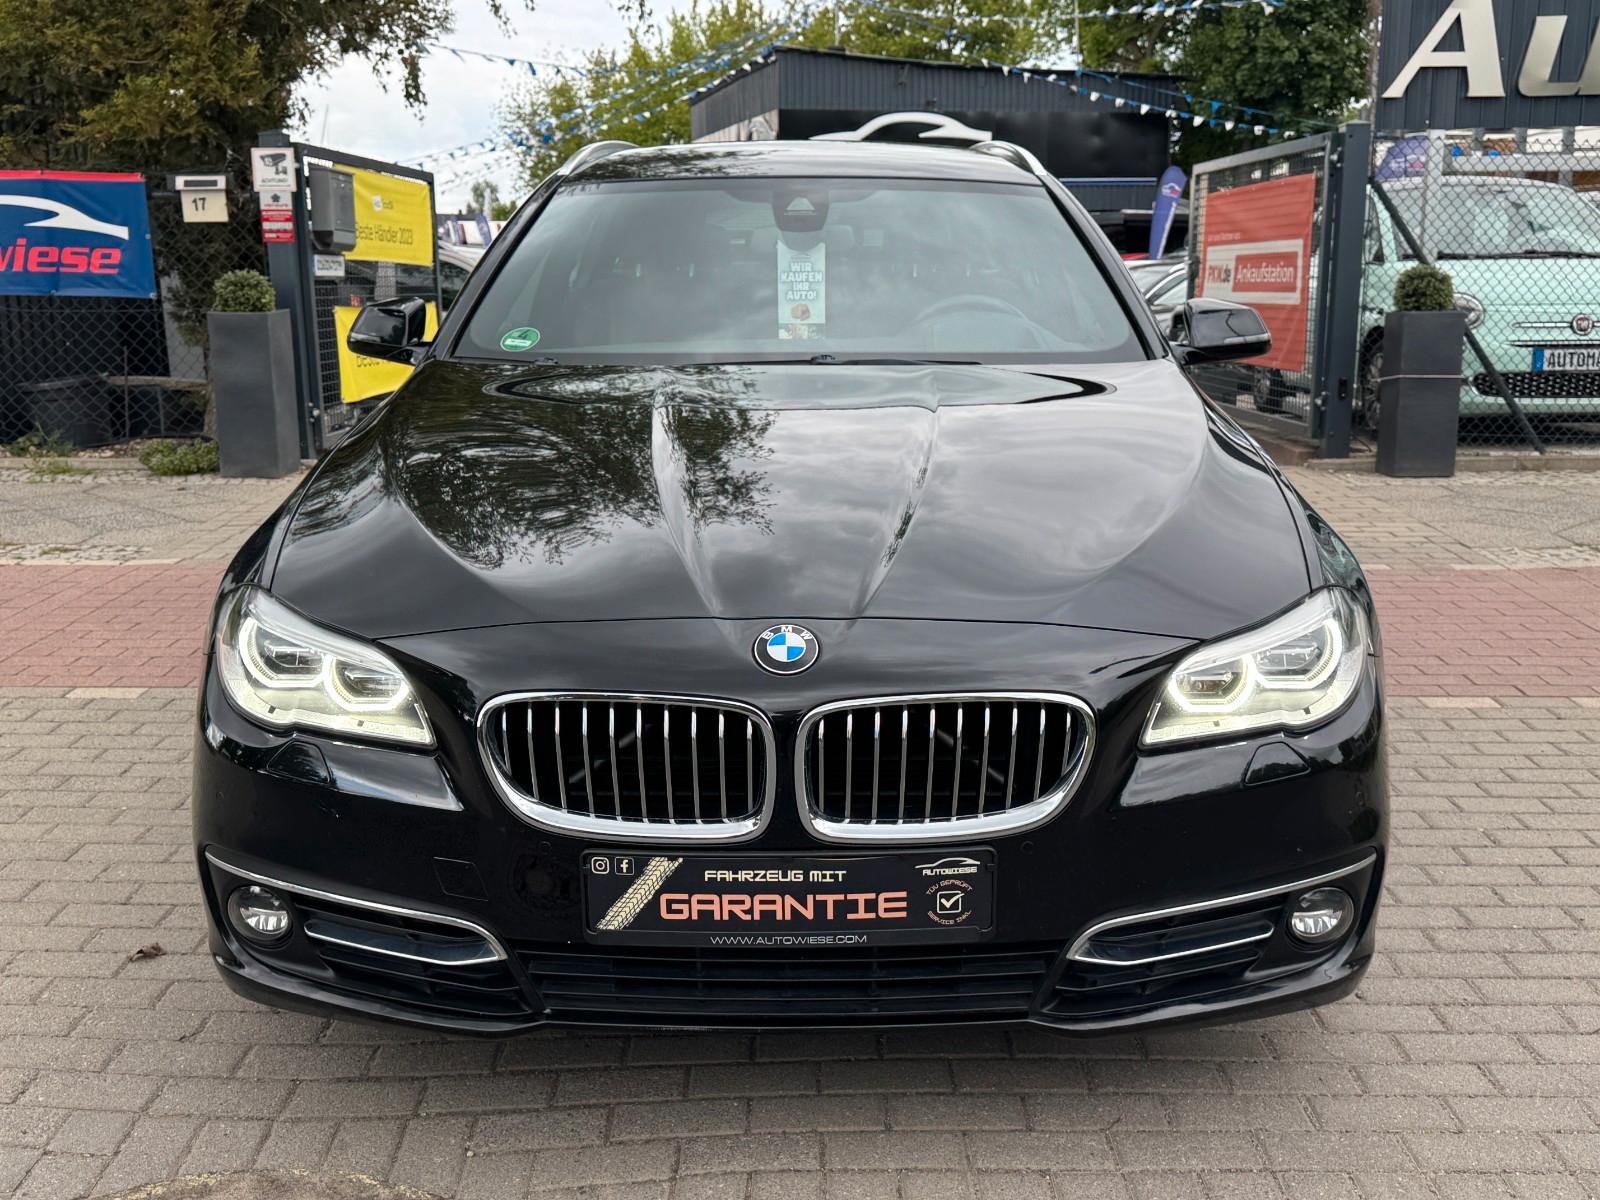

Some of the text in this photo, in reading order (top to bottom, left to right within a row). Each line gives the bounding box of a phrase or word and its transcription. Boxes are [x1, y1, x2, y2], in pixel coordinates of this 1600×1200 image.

[192, 197, 207, 211] 17
[790, 262, 812, 272] WIR
[1235, 261, 1294, 283] Ankaufstation
[781, 272, 823, 282] KAUFEN
[793, 282, 810, 291] IHR
[786, 291, 817, 301] AUTO!
[761, 626, 813, 640] BMW
[704, 869, 847, 882] FAHRZEUG MIT
[922, 866, 978, 876] AUTOWIESE
[659, 891, 908, 921] GARANTIE
[710, 935, 868, 945] WWW.AUTOWIESE.COM
